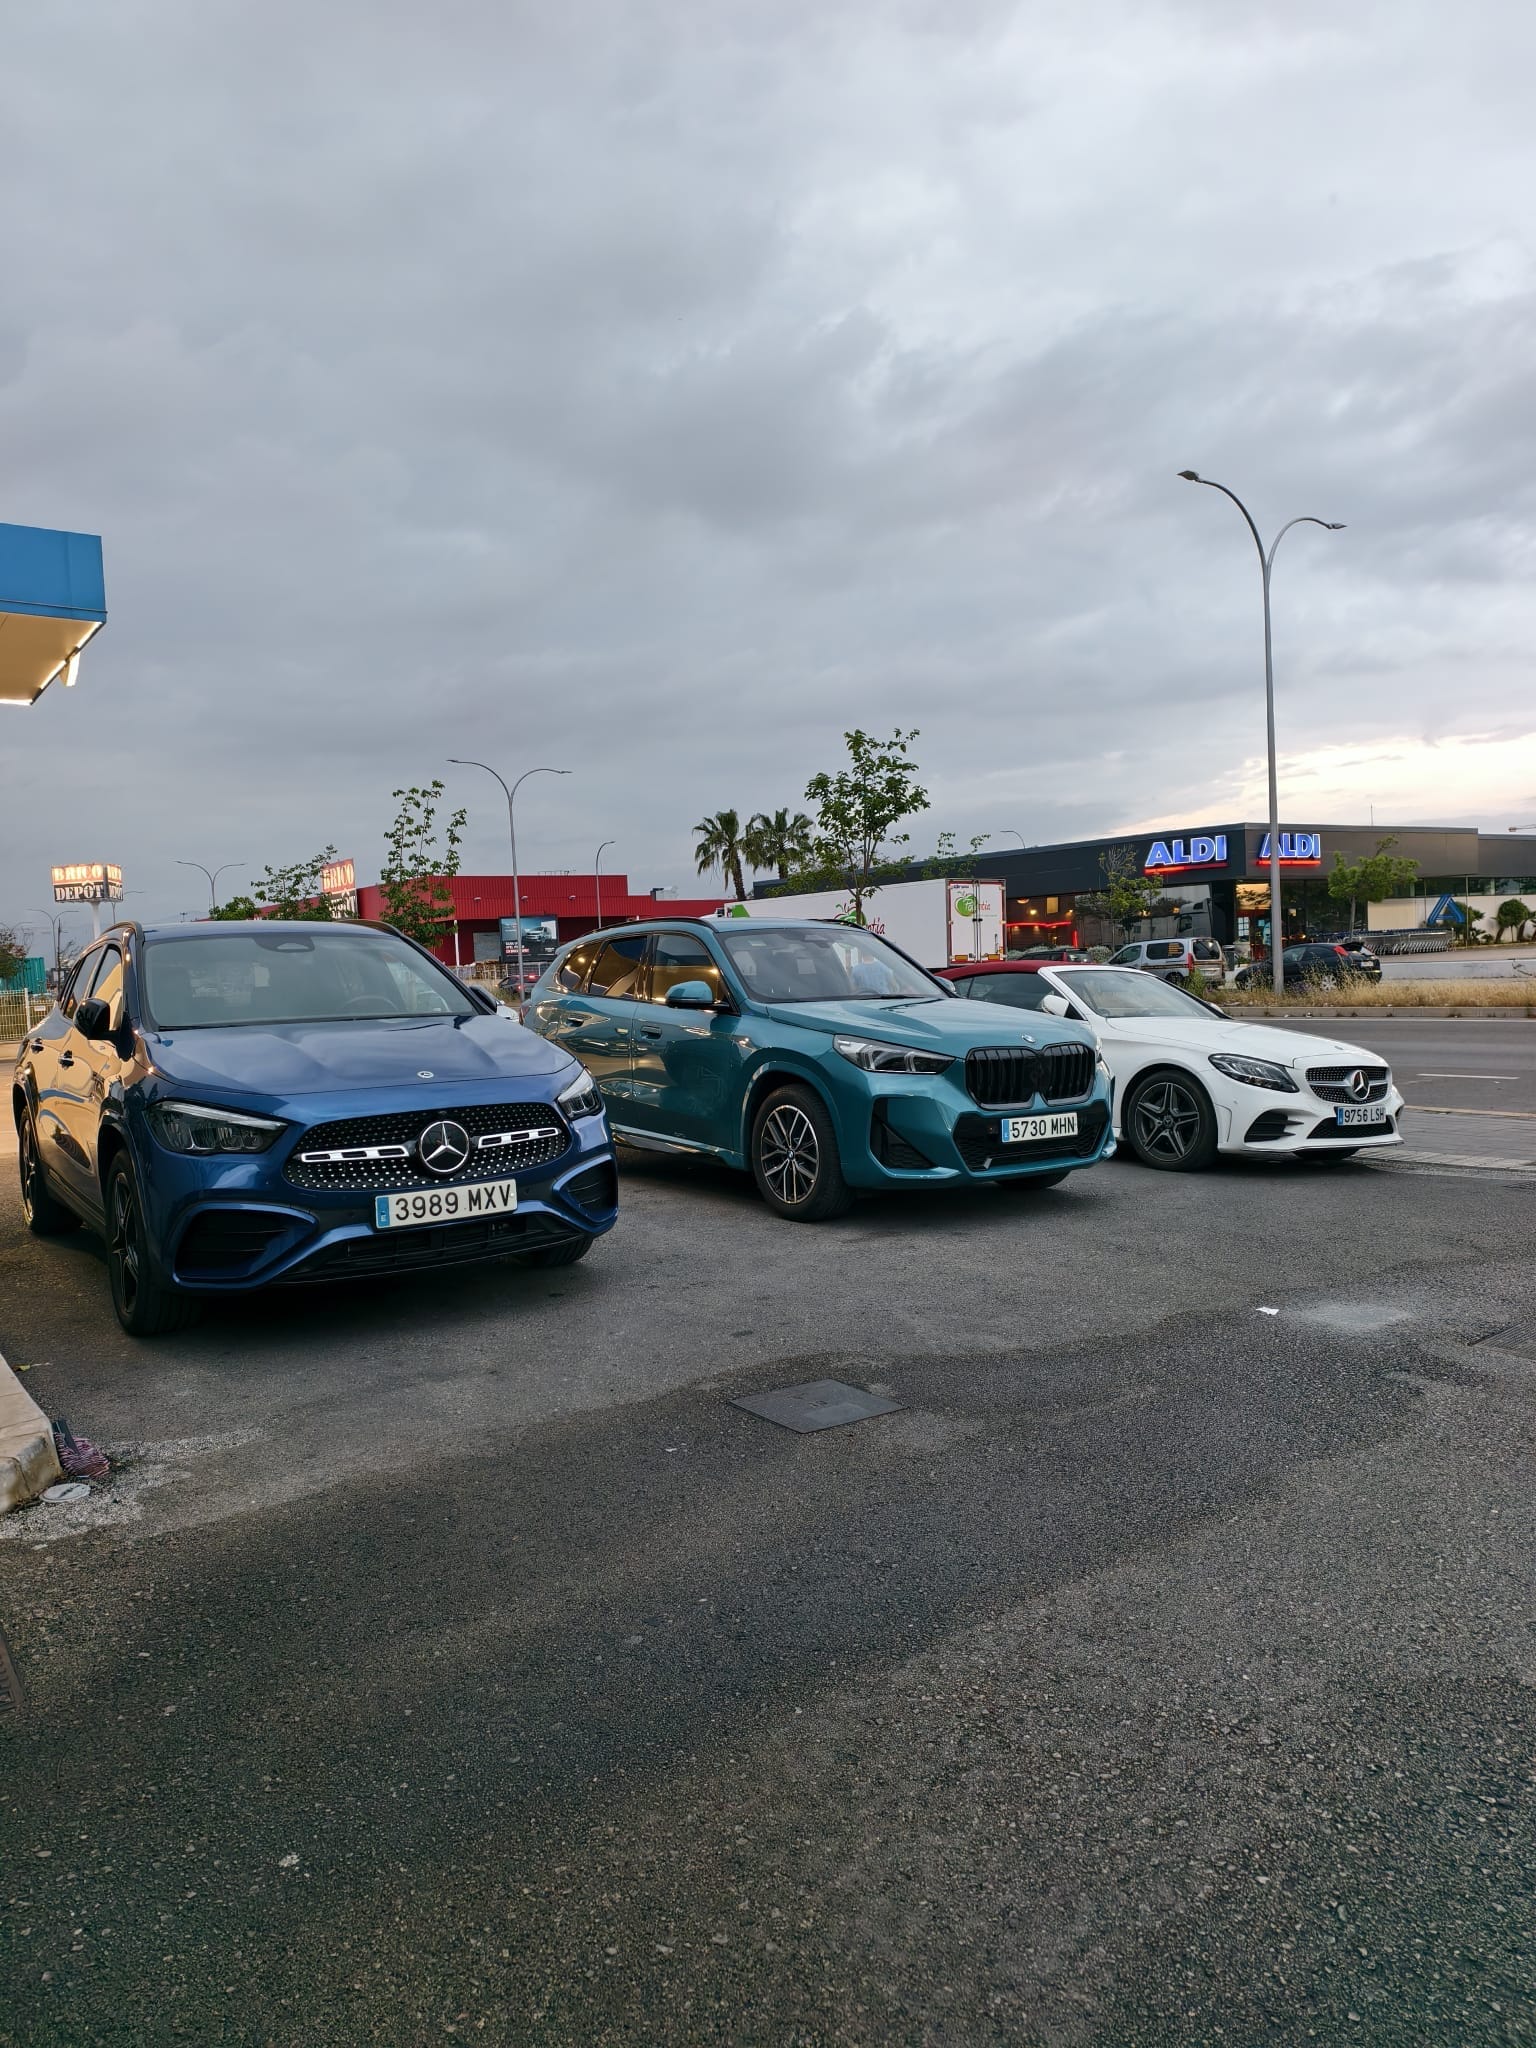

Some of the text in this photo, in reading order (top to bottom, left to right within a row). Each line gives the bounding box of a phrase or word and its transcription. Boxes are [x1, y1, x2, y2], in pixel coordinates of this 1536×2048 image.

[1145, 835, 1227, 867] ALDI
[1261, 832, 1321, 858] ALDI
[322, 863, 354, 890] BRICO
[1012, 1116, 1074, 1138] 5730 MHN
[1344, 1109, 1368, 1122] 9756
[395, 1184, 510, 1220] 3989 MXV
